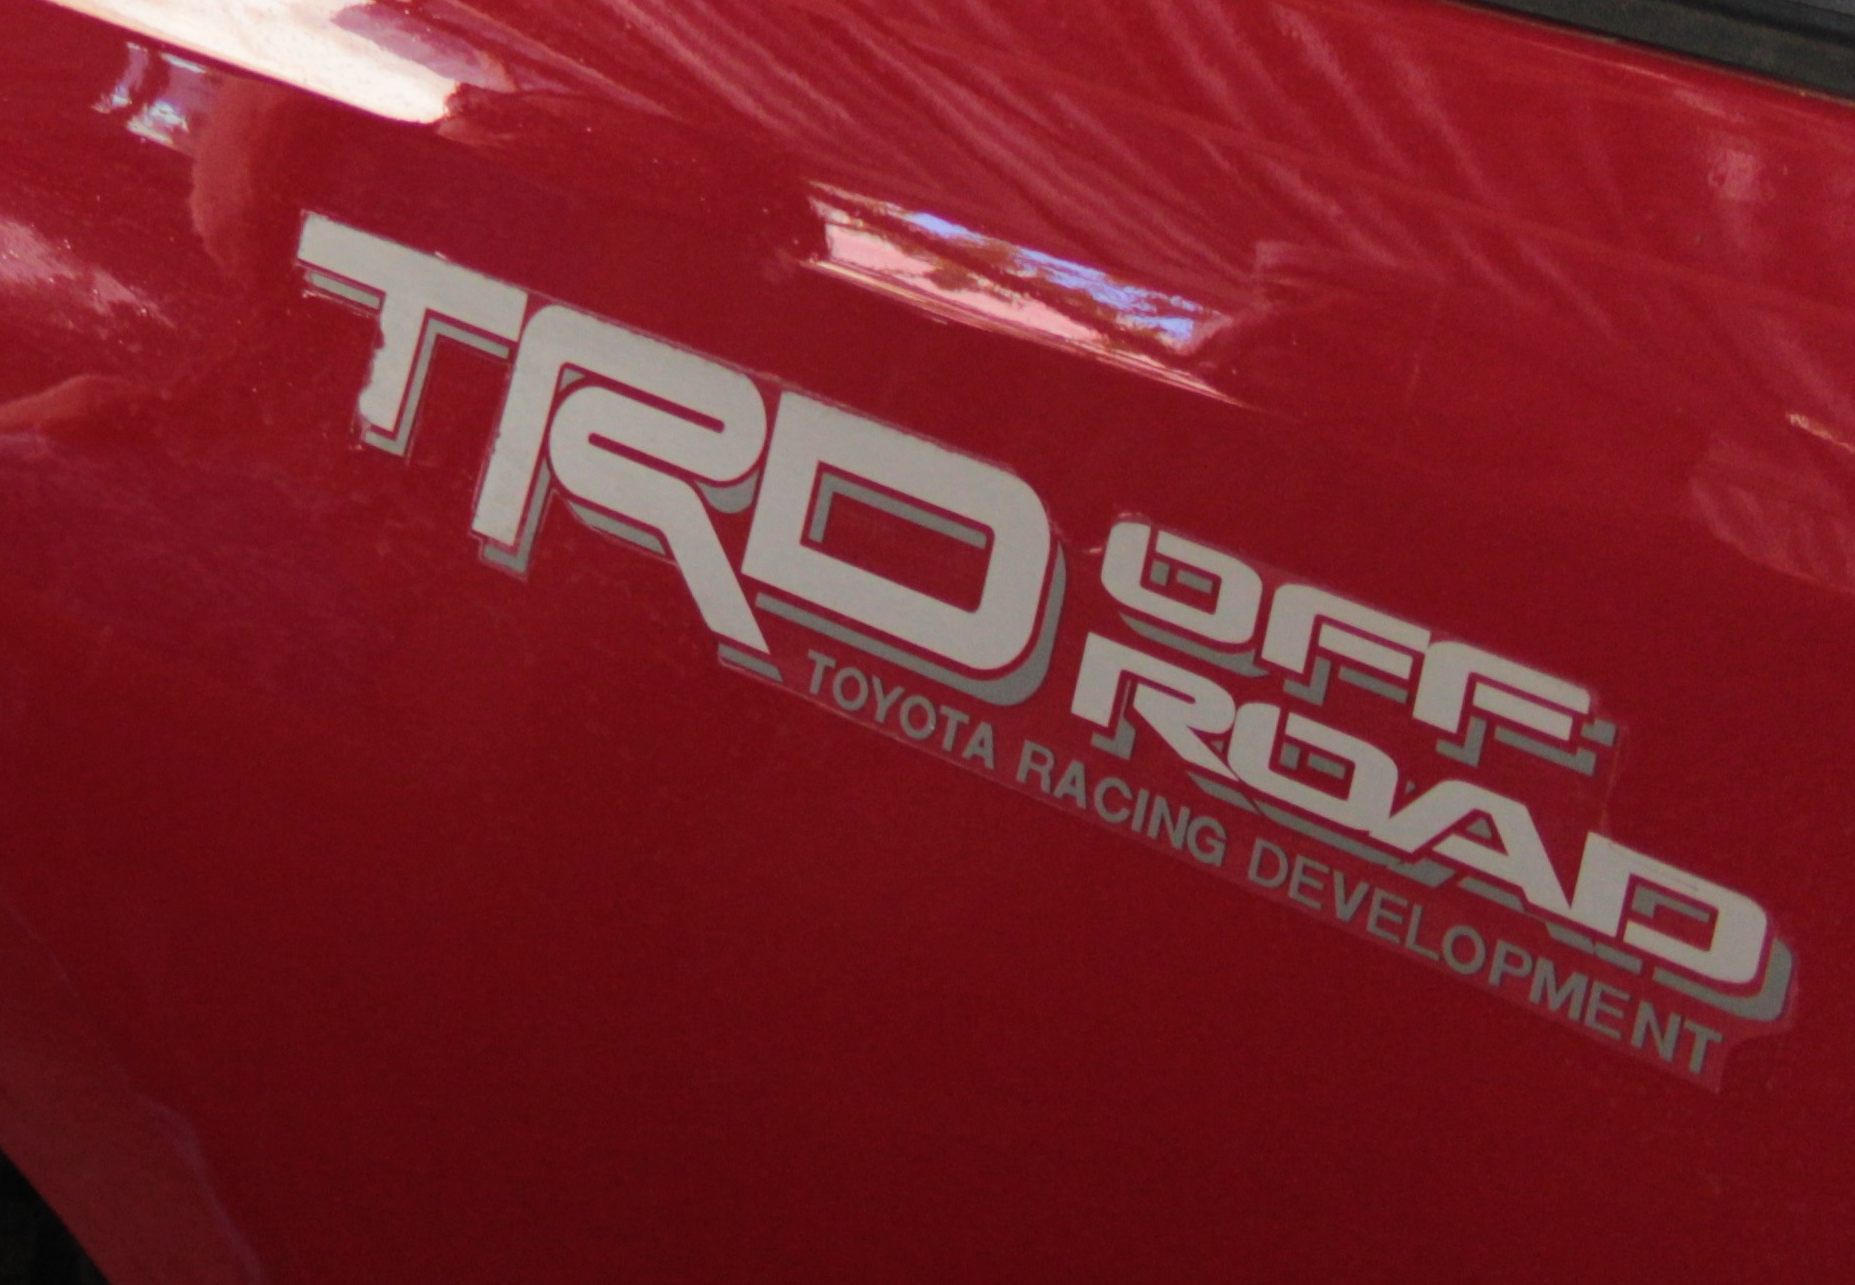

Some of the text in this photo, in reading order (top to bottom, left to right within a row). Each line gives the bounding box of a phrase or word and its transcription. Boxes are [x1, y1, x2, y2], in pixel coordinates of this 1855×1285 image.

[296, 211, 1067, 703] TRD
[1100, 515, 1618, 774] OFF
[806, 648, 1724, 1075] TOYOTA RACING DEVELOPMENT
[1070, 631, 1793, 1023] ROAD
